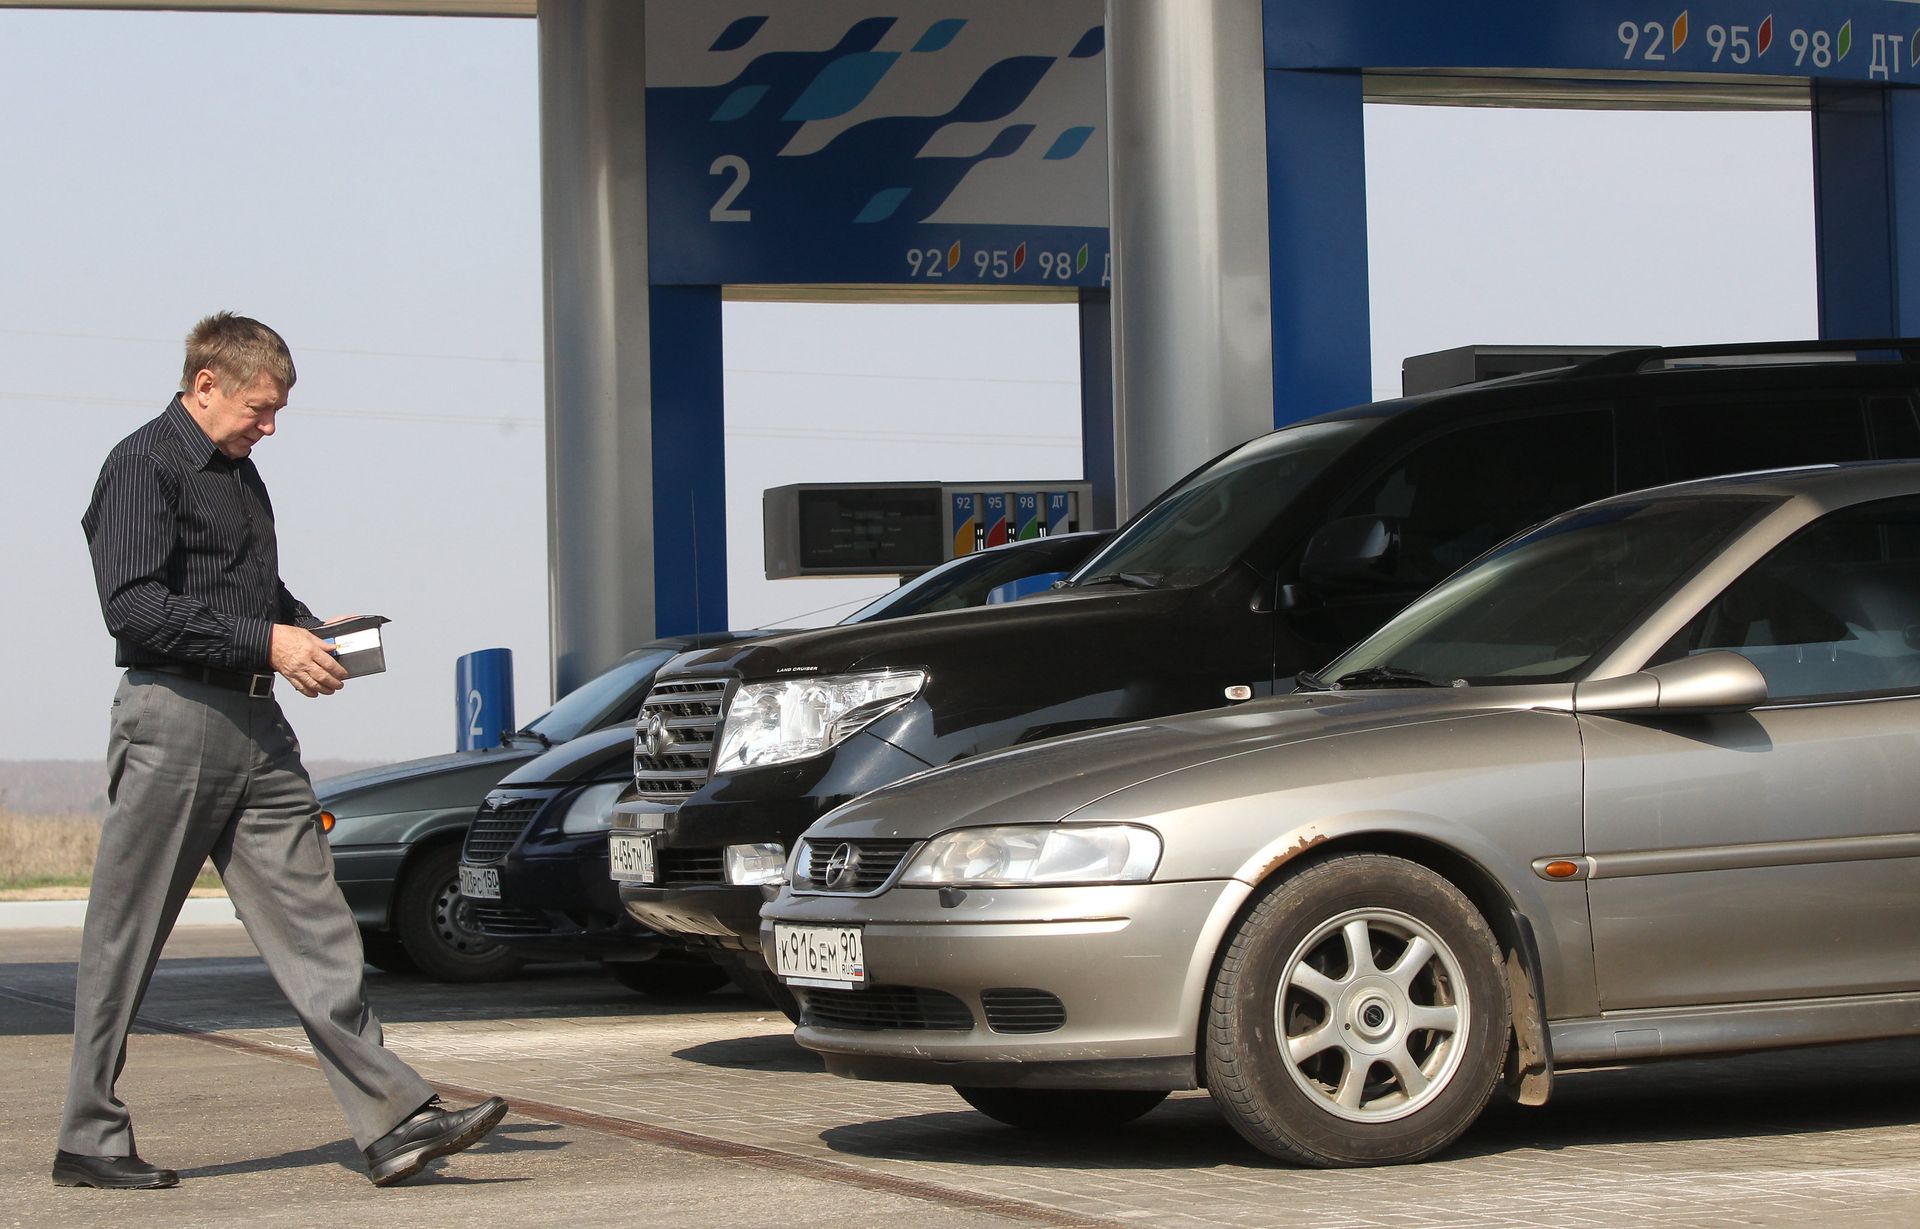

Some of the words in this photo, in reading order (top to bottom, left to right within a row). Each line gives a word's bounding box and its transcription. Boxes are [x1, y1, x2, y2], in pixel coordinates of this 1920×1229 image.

[1617, 21, 1665, 61] 92
[1705, 24, 1751, 64] 95
[1789, 28, 1832, 68] 98
[1868, 33, 1903, 80] ДТ
[709, 154, 751, 222] 2
[906, 249, 943, 277] 92
[973, 250, 1009, 278] 95
[1038, 252, 1072, 280] 98
[956, 497, 971, 509] 92
[988, 497, 1003, 509] 95
[1020, 496, 1035, 509] 98
[1052, 495, 1065, 509] ДТ
[468, 688, 483, 736] 2
[840, 932, 857, 963] 90
[841, 964, 855, 976] RUS
